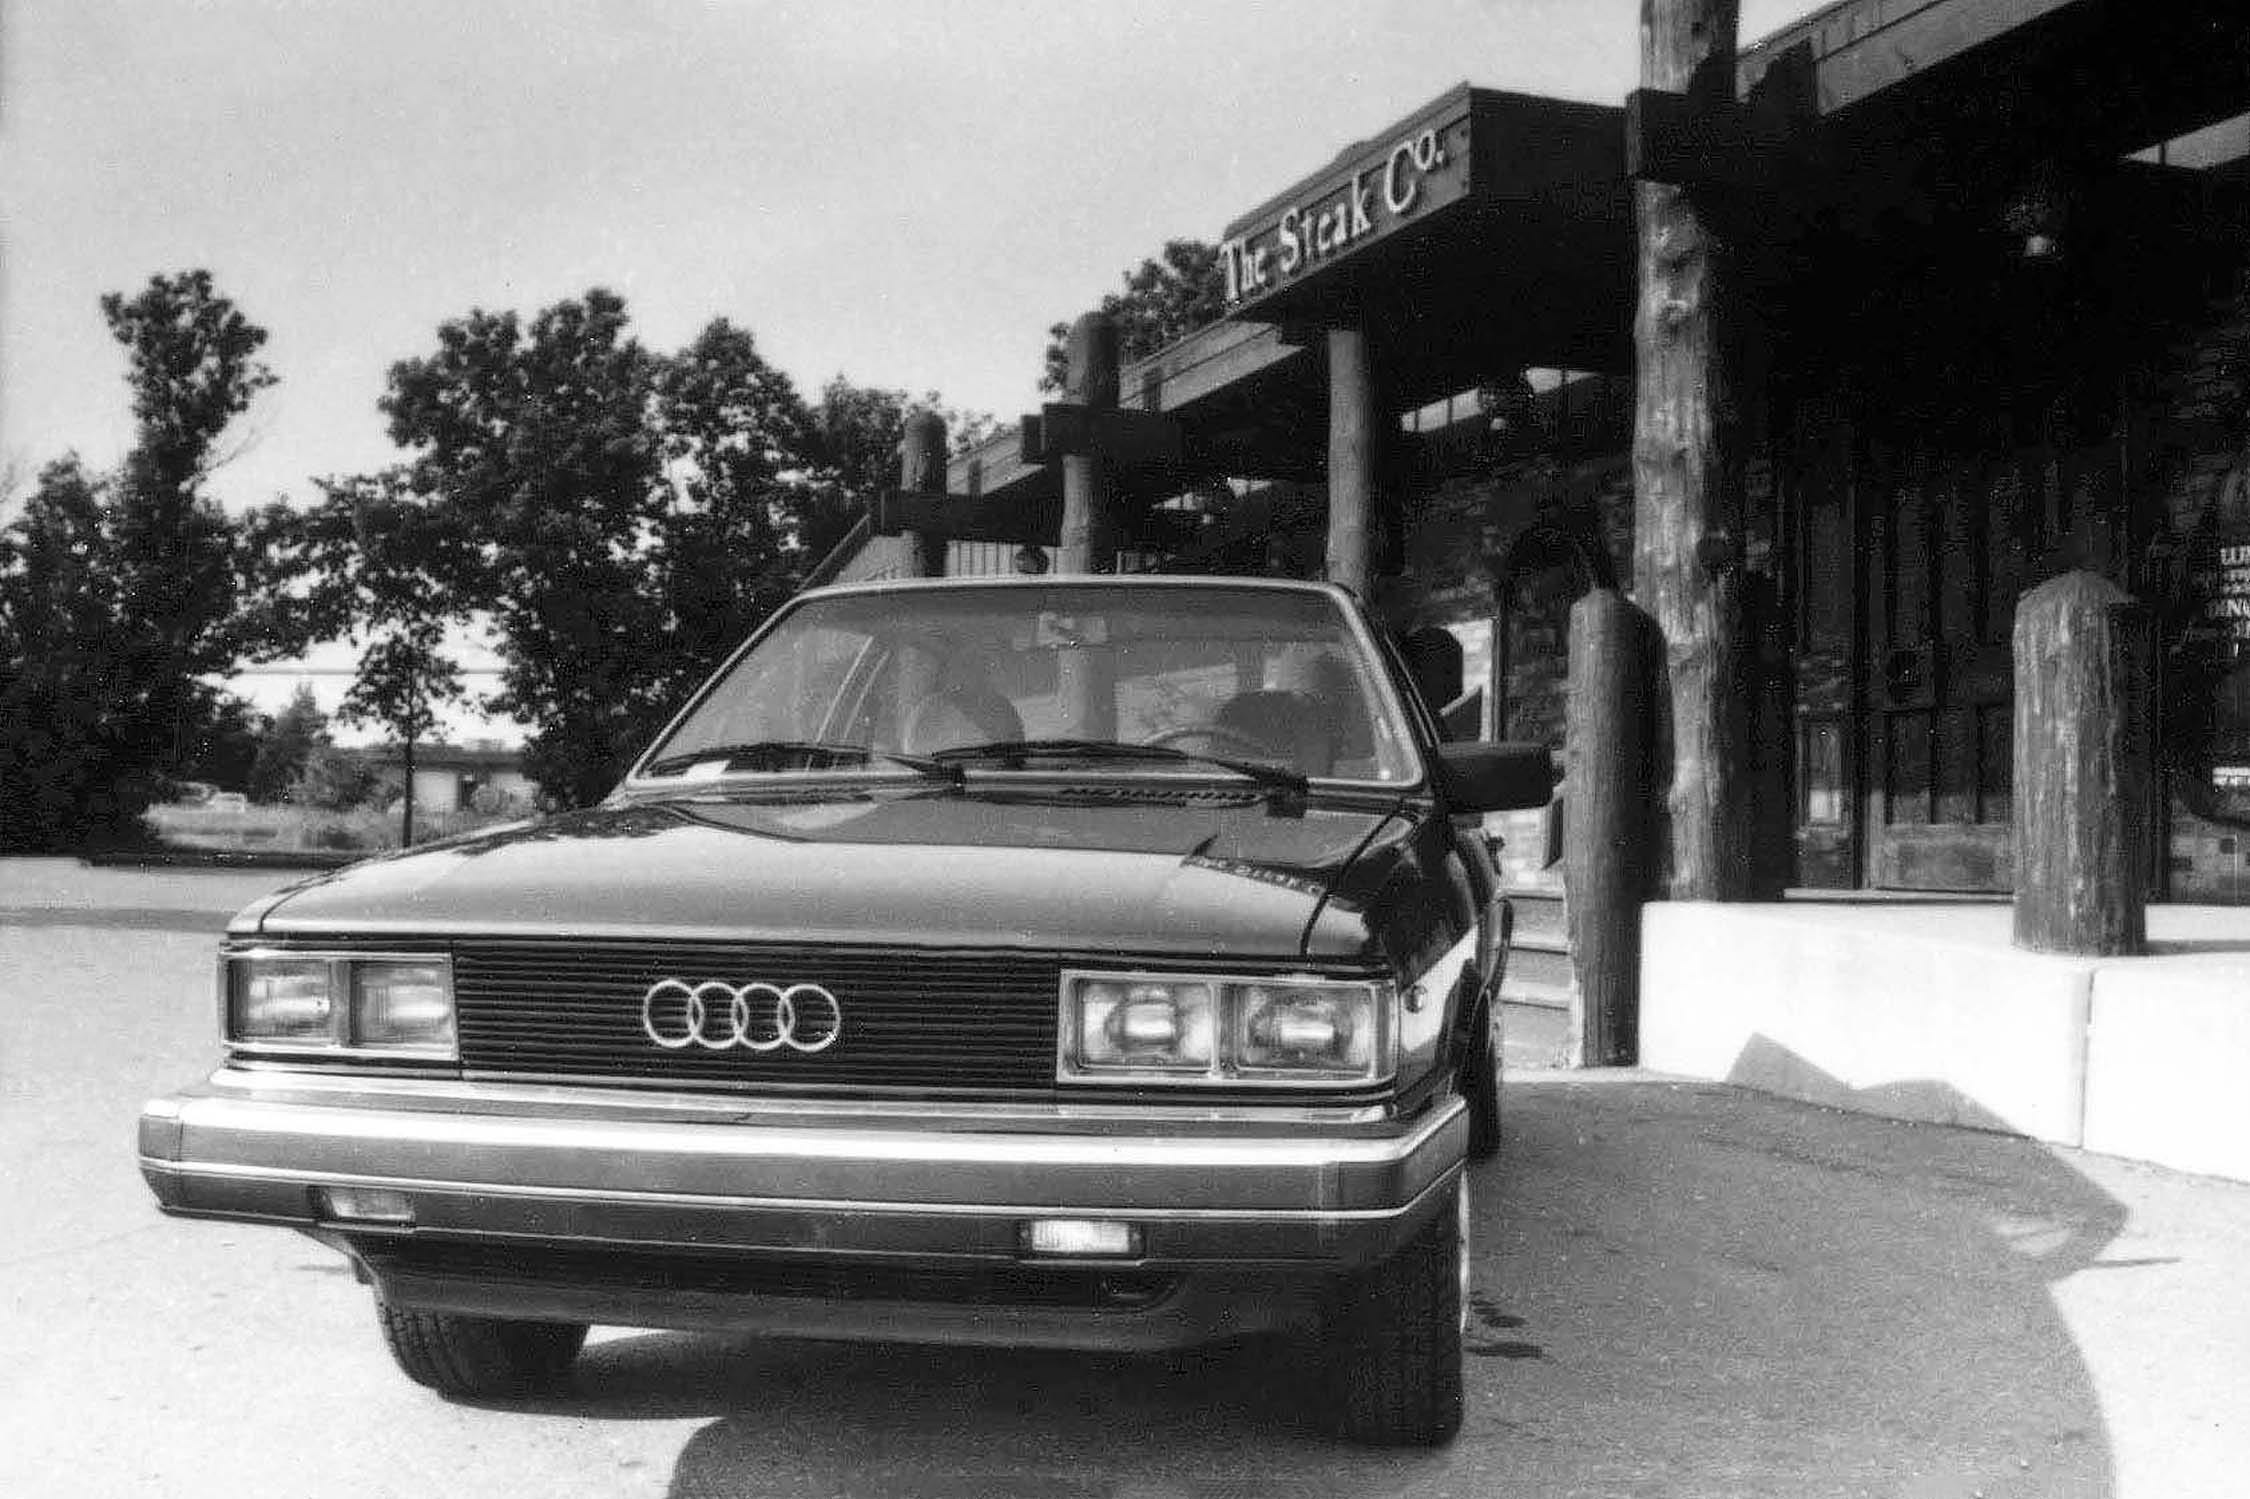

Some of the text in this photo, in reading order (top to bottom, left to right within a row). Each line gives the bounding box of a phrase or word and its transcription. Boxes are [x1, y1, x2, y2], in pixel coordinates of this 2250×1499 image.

[1219, 129, 1444, 301] The Steak Co.
